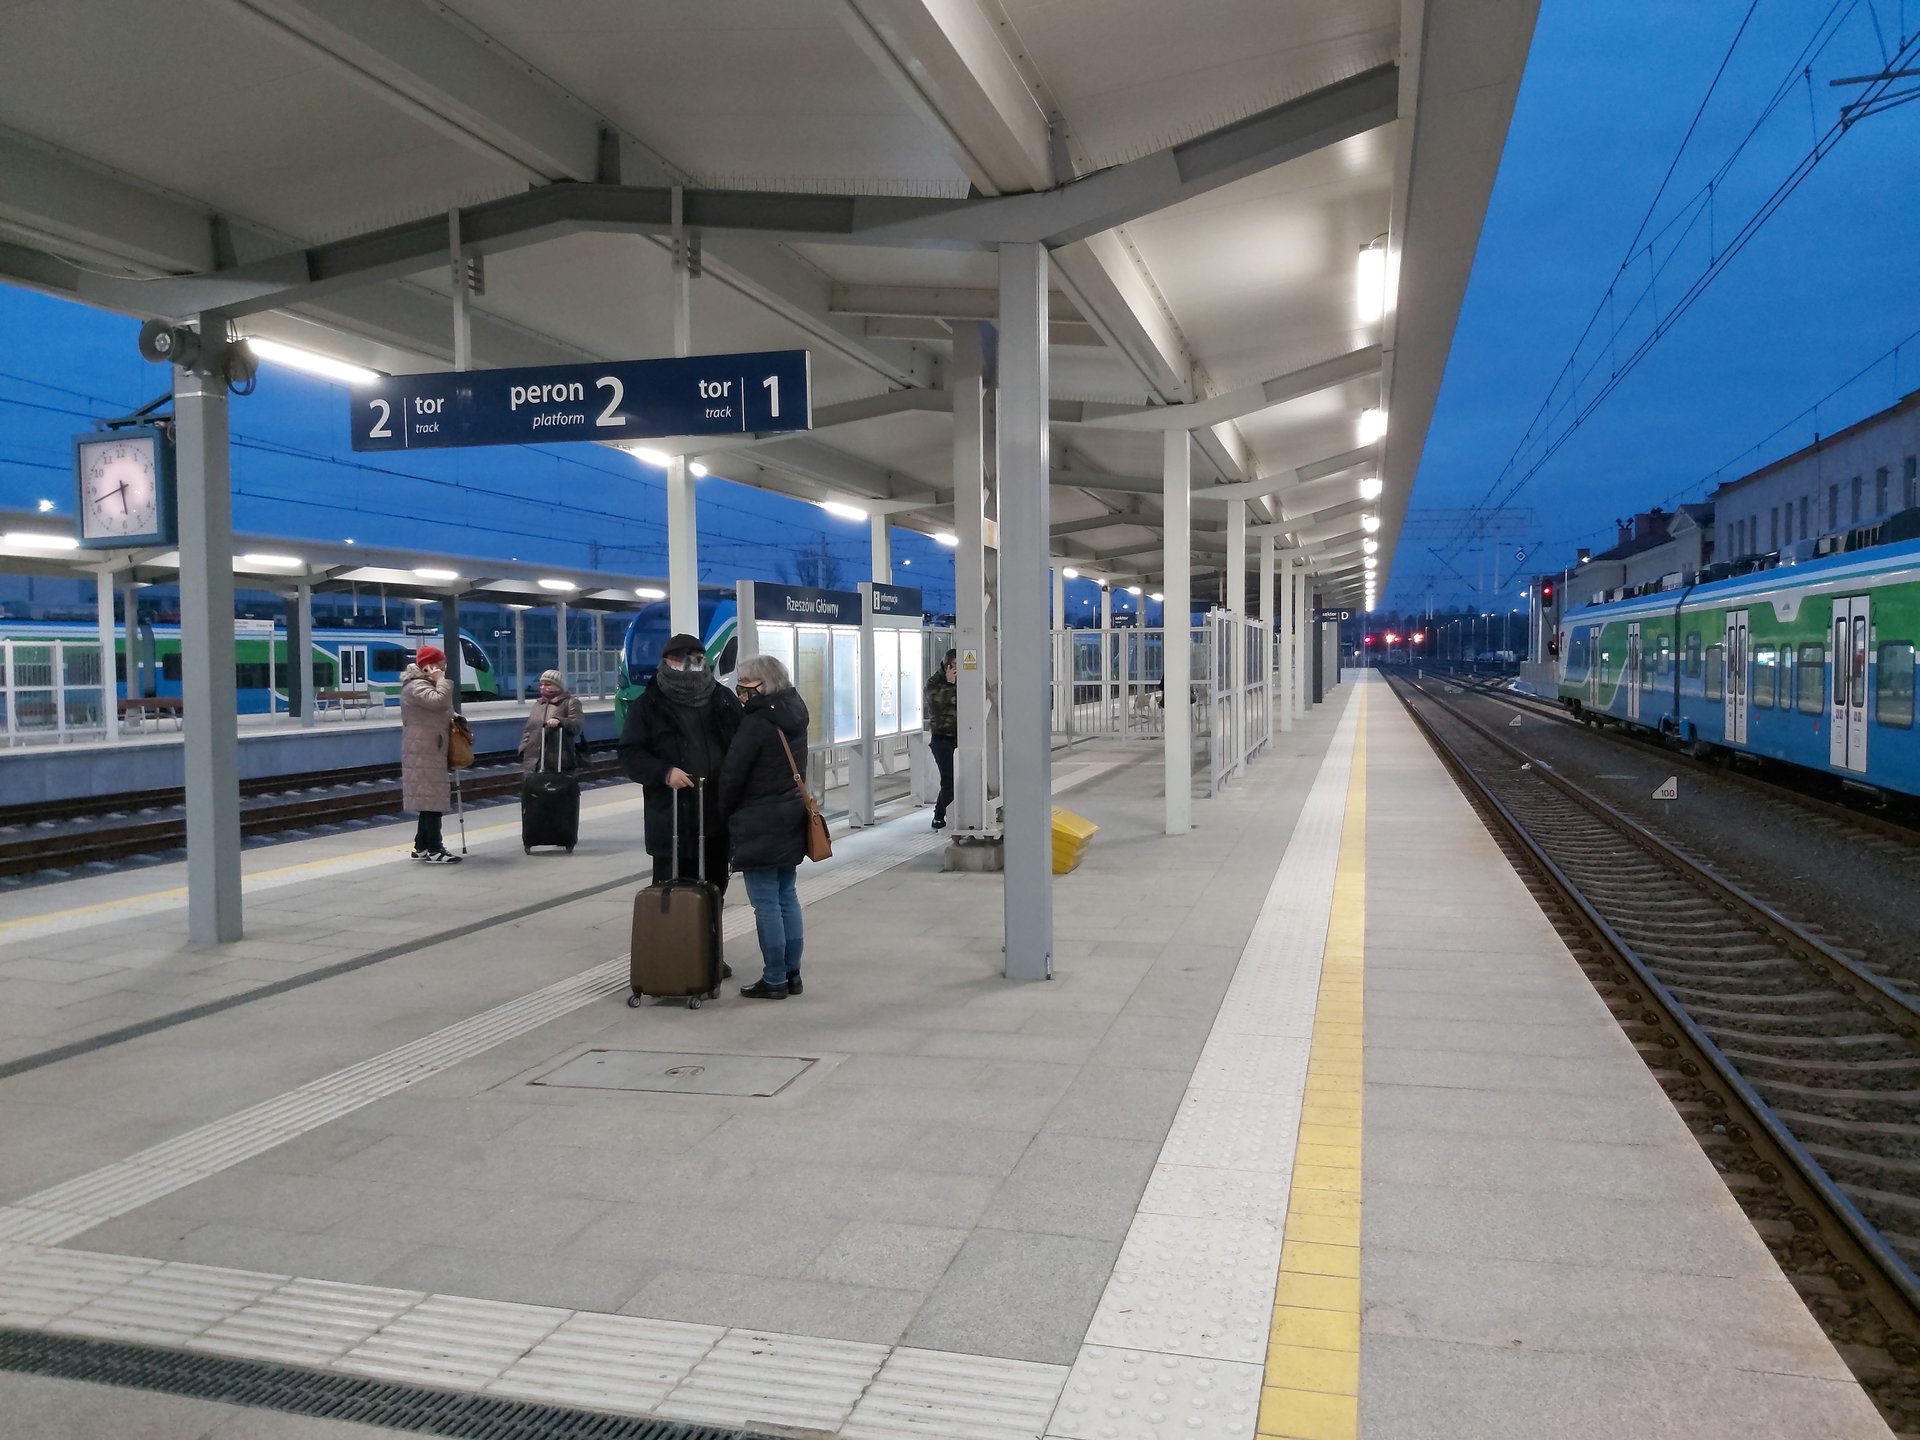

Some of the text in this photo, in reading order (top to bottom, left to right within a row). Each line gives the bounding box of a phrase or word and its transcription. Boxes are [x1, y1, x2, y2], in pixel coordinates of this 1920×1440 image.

[698, 375, 781, 417] tor 1
[510, 376, 626, 427] peron 2
[705, 405, 732, 419] track
[369, 396, 445, 438] 2 tor
[532, 411, 585, 430] platform
[415, 420, 440, 434] track
[116, 448, 125, 458] 12
[134, 453, 138, 462] 1
[104, 456, 112, 464] 11
[95, 469, 104, 478] 10
[143, 464, 149, 474] 2
[149, 482, 154, 491] 3
[91, 487, 97, 496] 9
[97, 505, 102, 514] 8
[145, 501, 151, 509] 4
[108, 517, 113, 525] 7
[136, 515, 141, 524] 5
[122, 520, 127, 529] 6
[786, 595, 839, 618] Rzeszów Główny
[1341, 611, 1349, 620] D
[1661, 789, 1675, 797] 100
